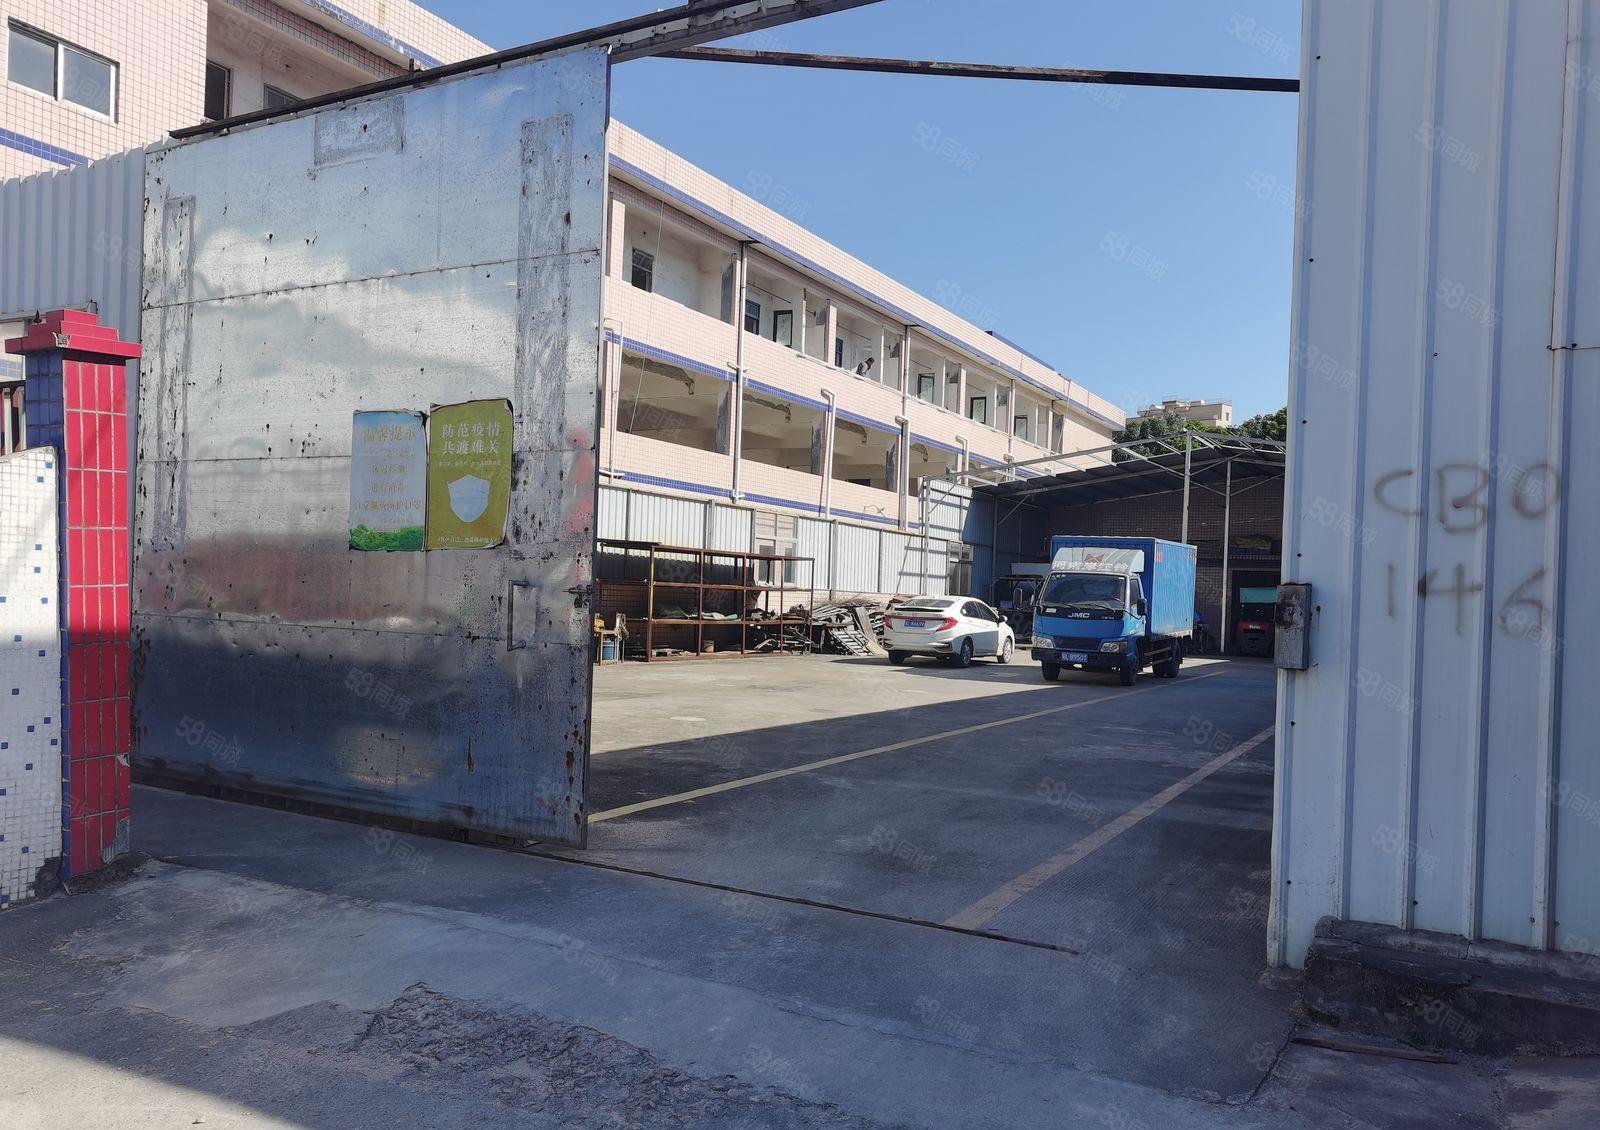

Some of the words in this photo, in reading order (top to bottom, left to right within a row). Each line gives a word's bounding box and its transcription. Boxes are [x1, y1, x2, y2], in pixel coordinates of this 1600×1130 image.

[442, 422, 501, 438] 防范疫情
[442, 439, 500, 455] 共渡难关
[1386, 562, 1551, 638] 146
